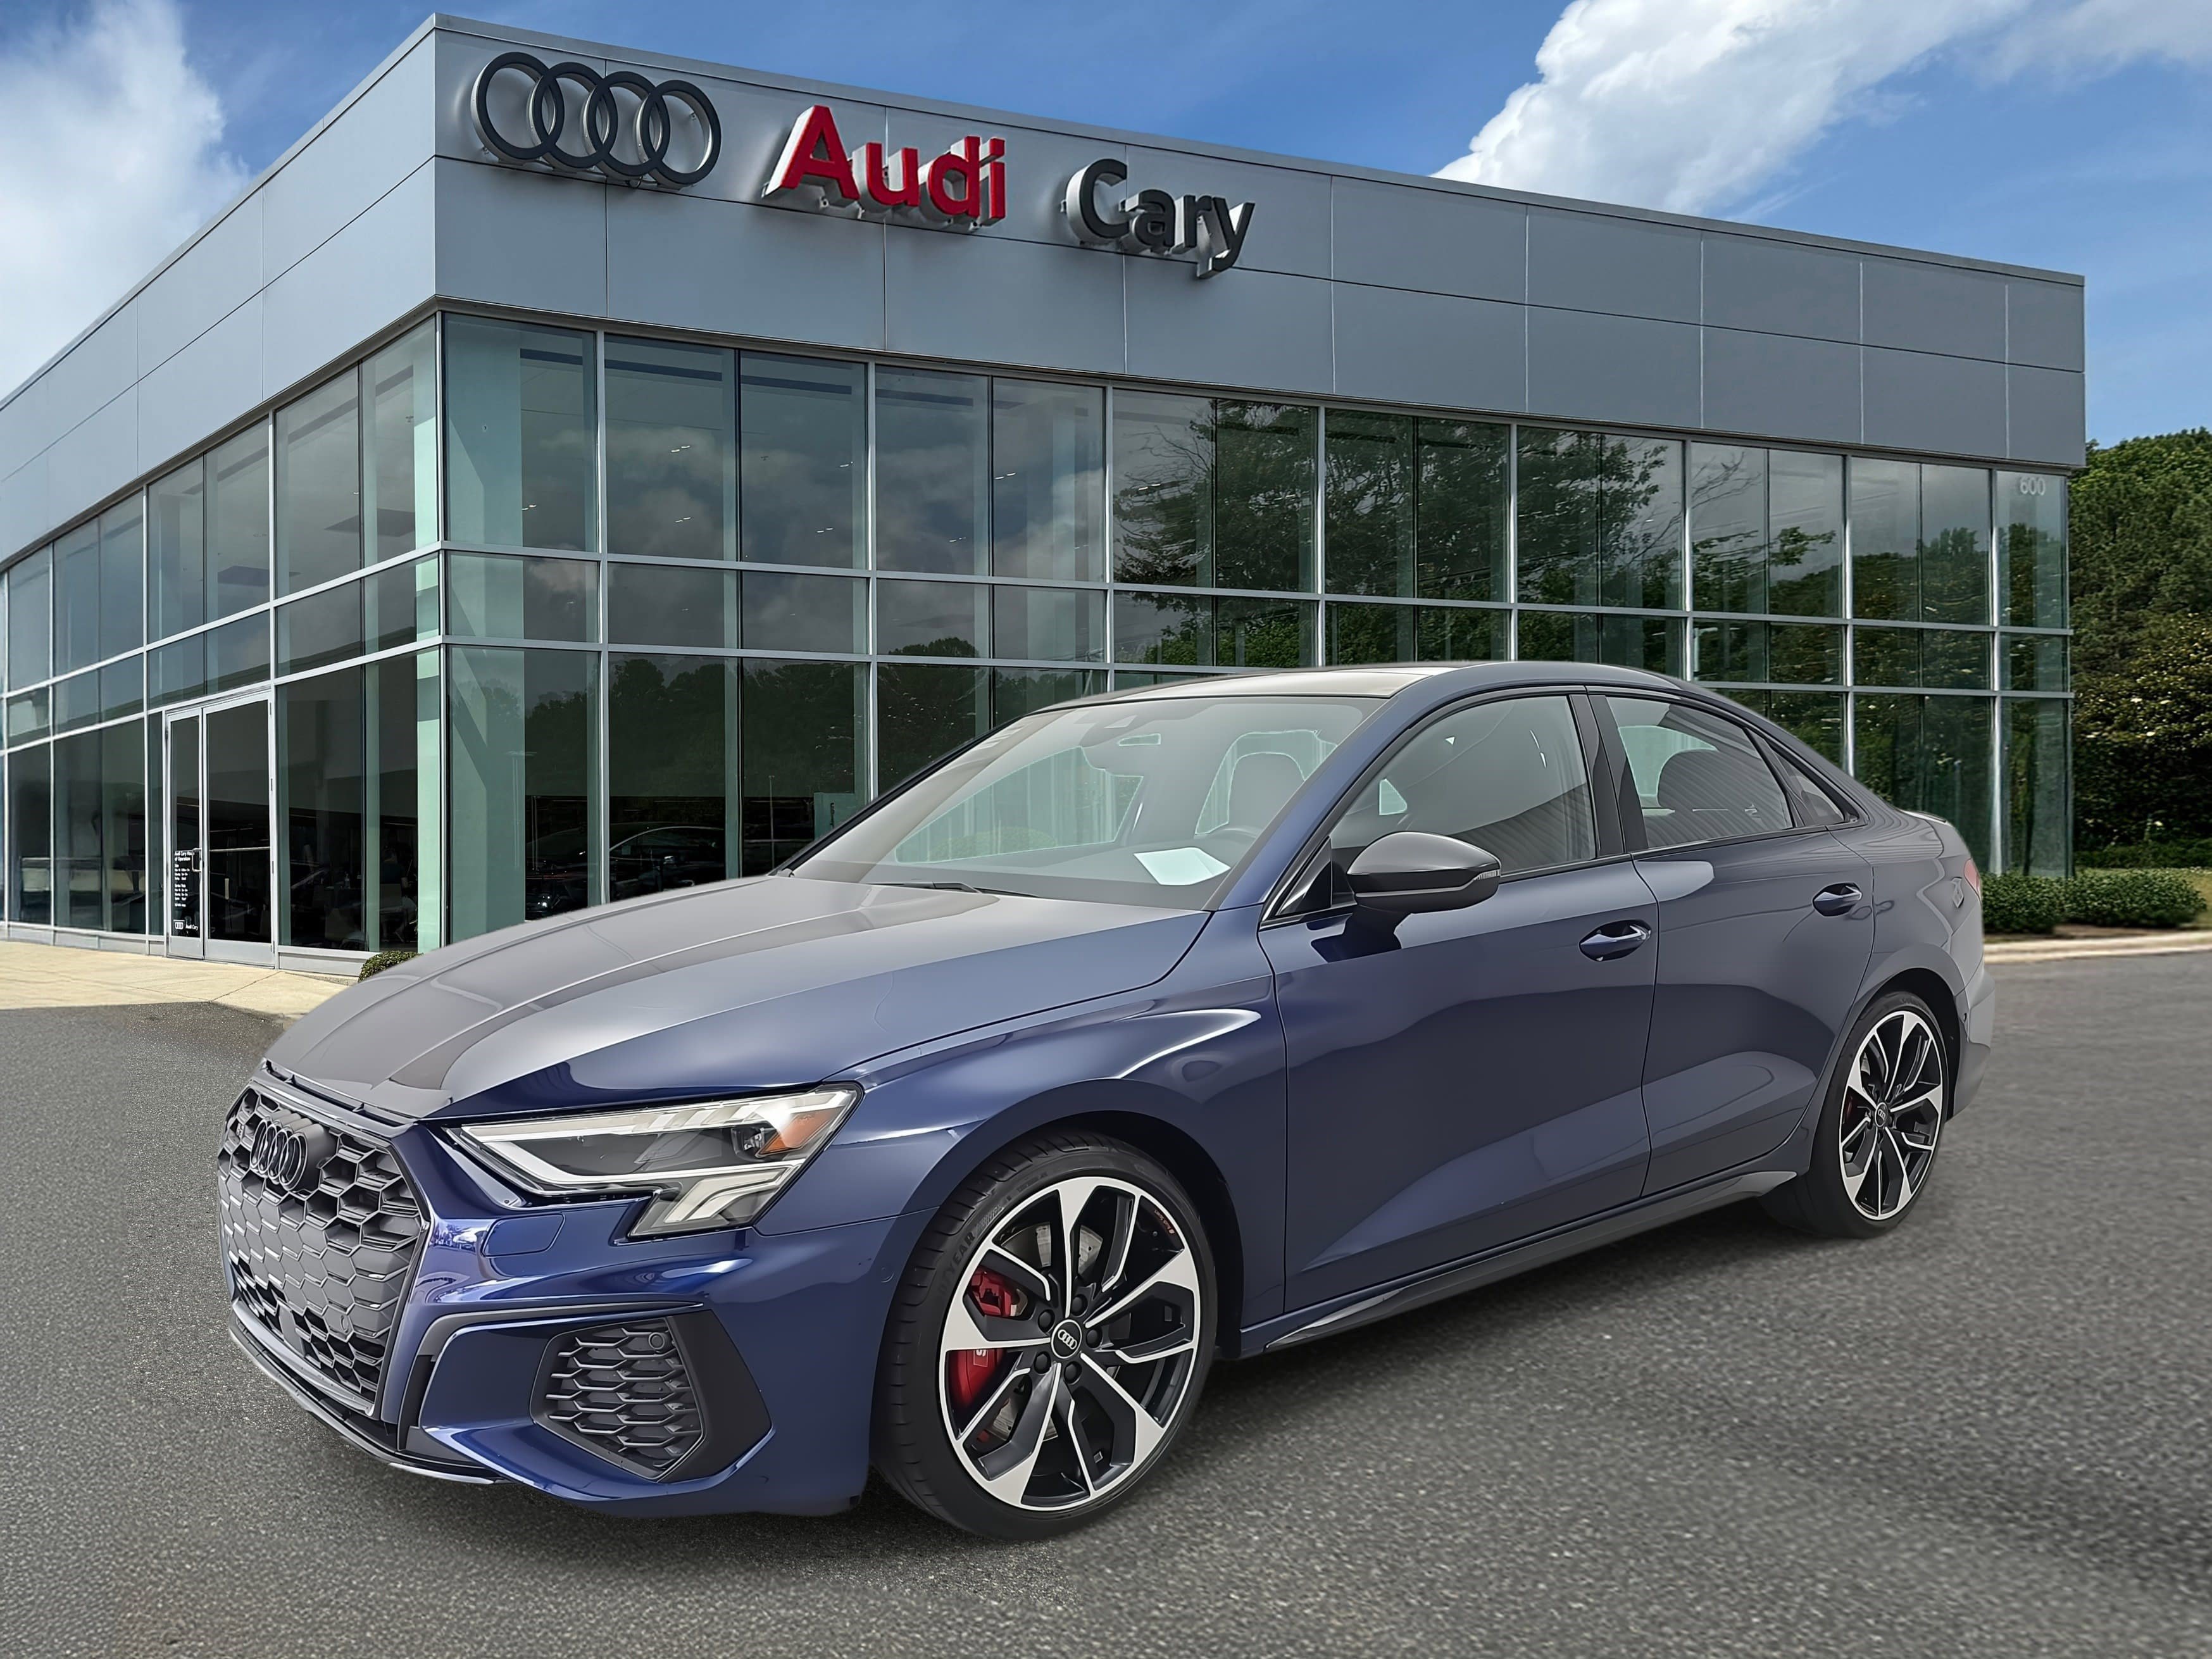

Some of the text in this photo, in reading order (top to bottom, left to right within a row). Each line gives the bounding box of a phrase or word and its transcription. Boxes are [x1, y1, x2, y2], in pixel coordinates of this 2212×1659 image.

[763, 104, 1256, 278] Audi Cary
[2020, 476, 2046, 496] 600
